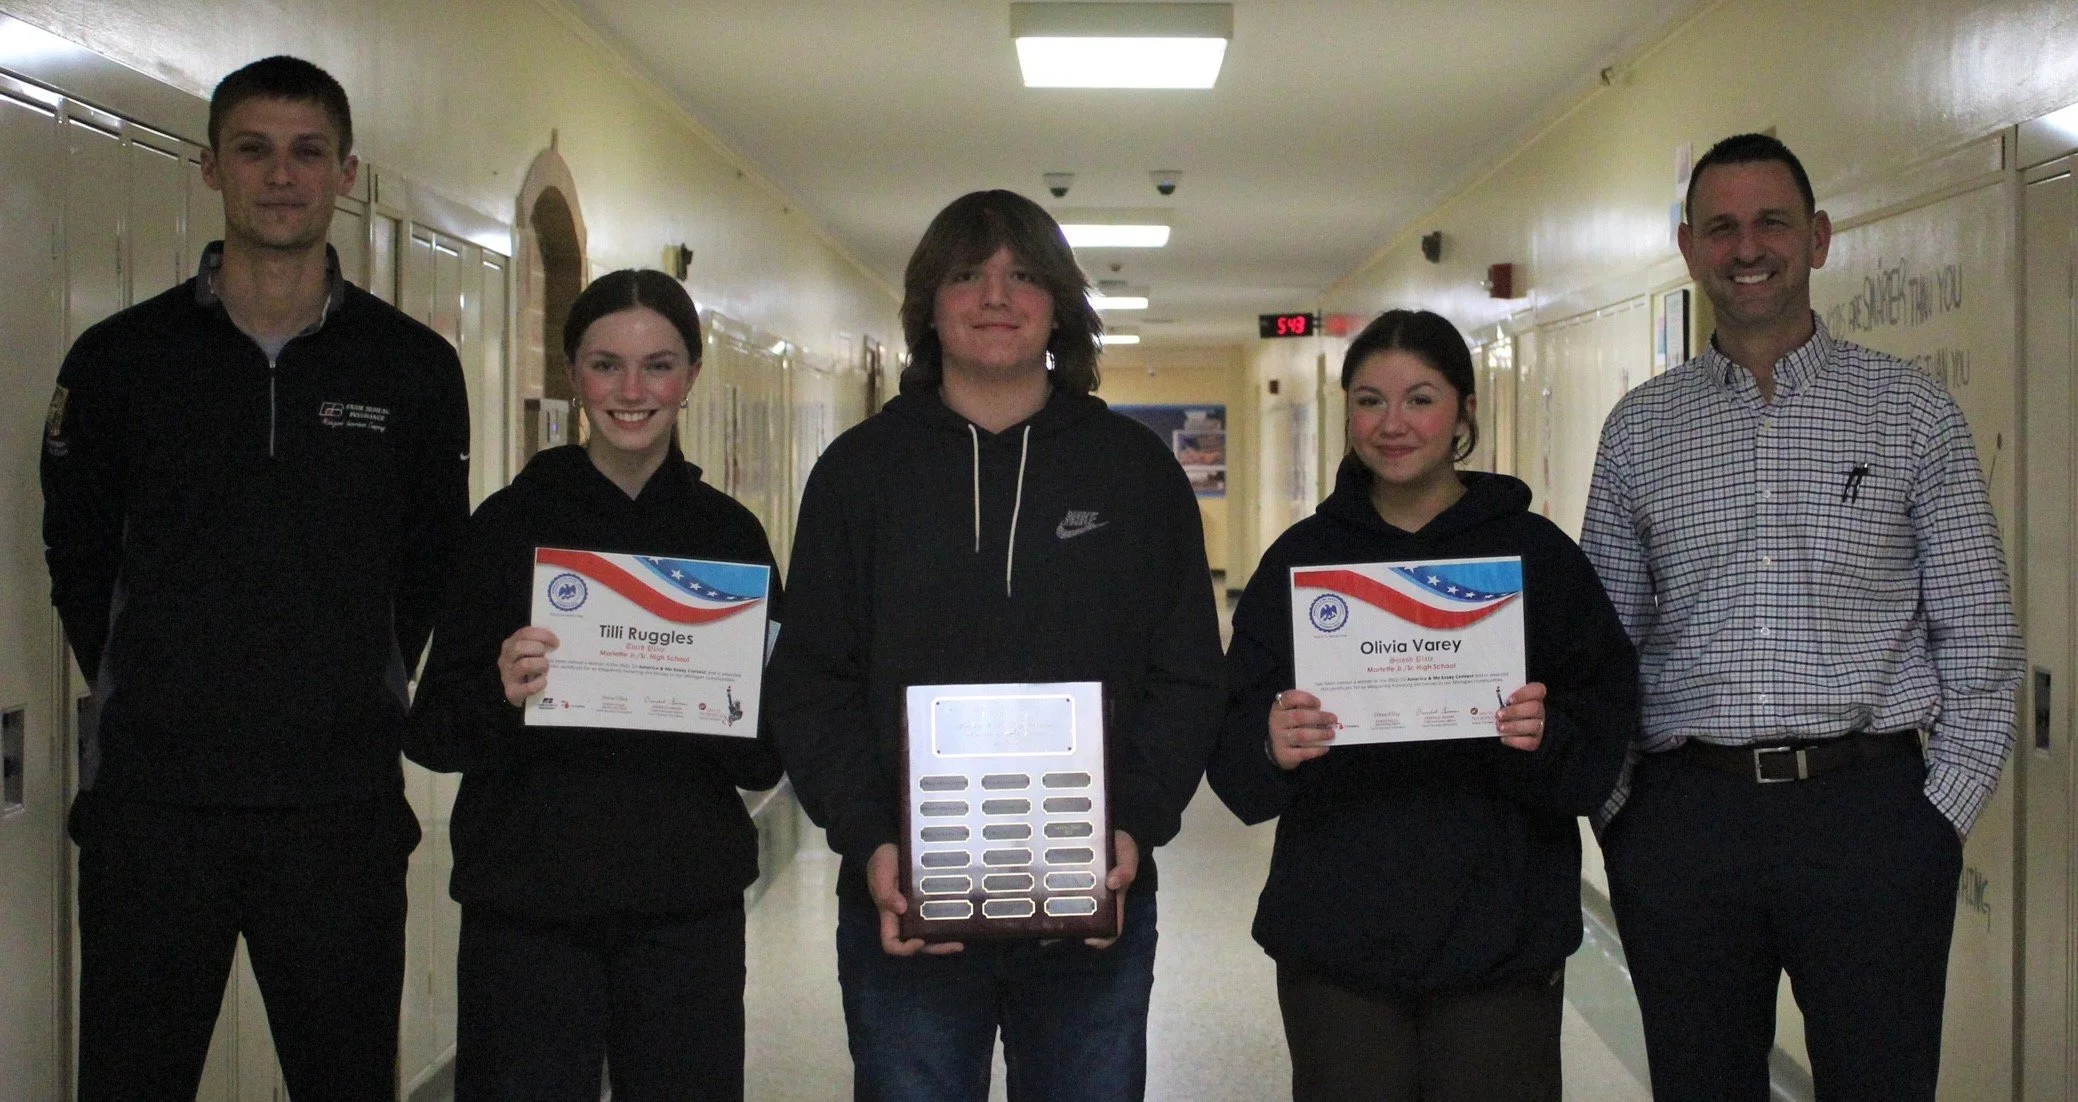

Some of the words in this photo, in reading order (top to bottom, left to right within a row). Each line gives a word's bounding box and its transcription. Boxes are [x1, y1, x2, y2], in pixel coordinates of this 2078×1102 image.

[1936, 263, 1963, 313] YOU
[1950, 348, 1971, 389] YOU
[600, 625, 623, 639] Tilli
[628, 627, 694, 646] Ruggles
[1360, 639, 1407, 655] Olivia
[1412, 639, 1462, 653] Varey
[600, 650, 628, 658] Marlette
[666, 655, 690, 663] School
[1416, 663, 1432, 671] High
[1433, 662, 1457, 670] School
